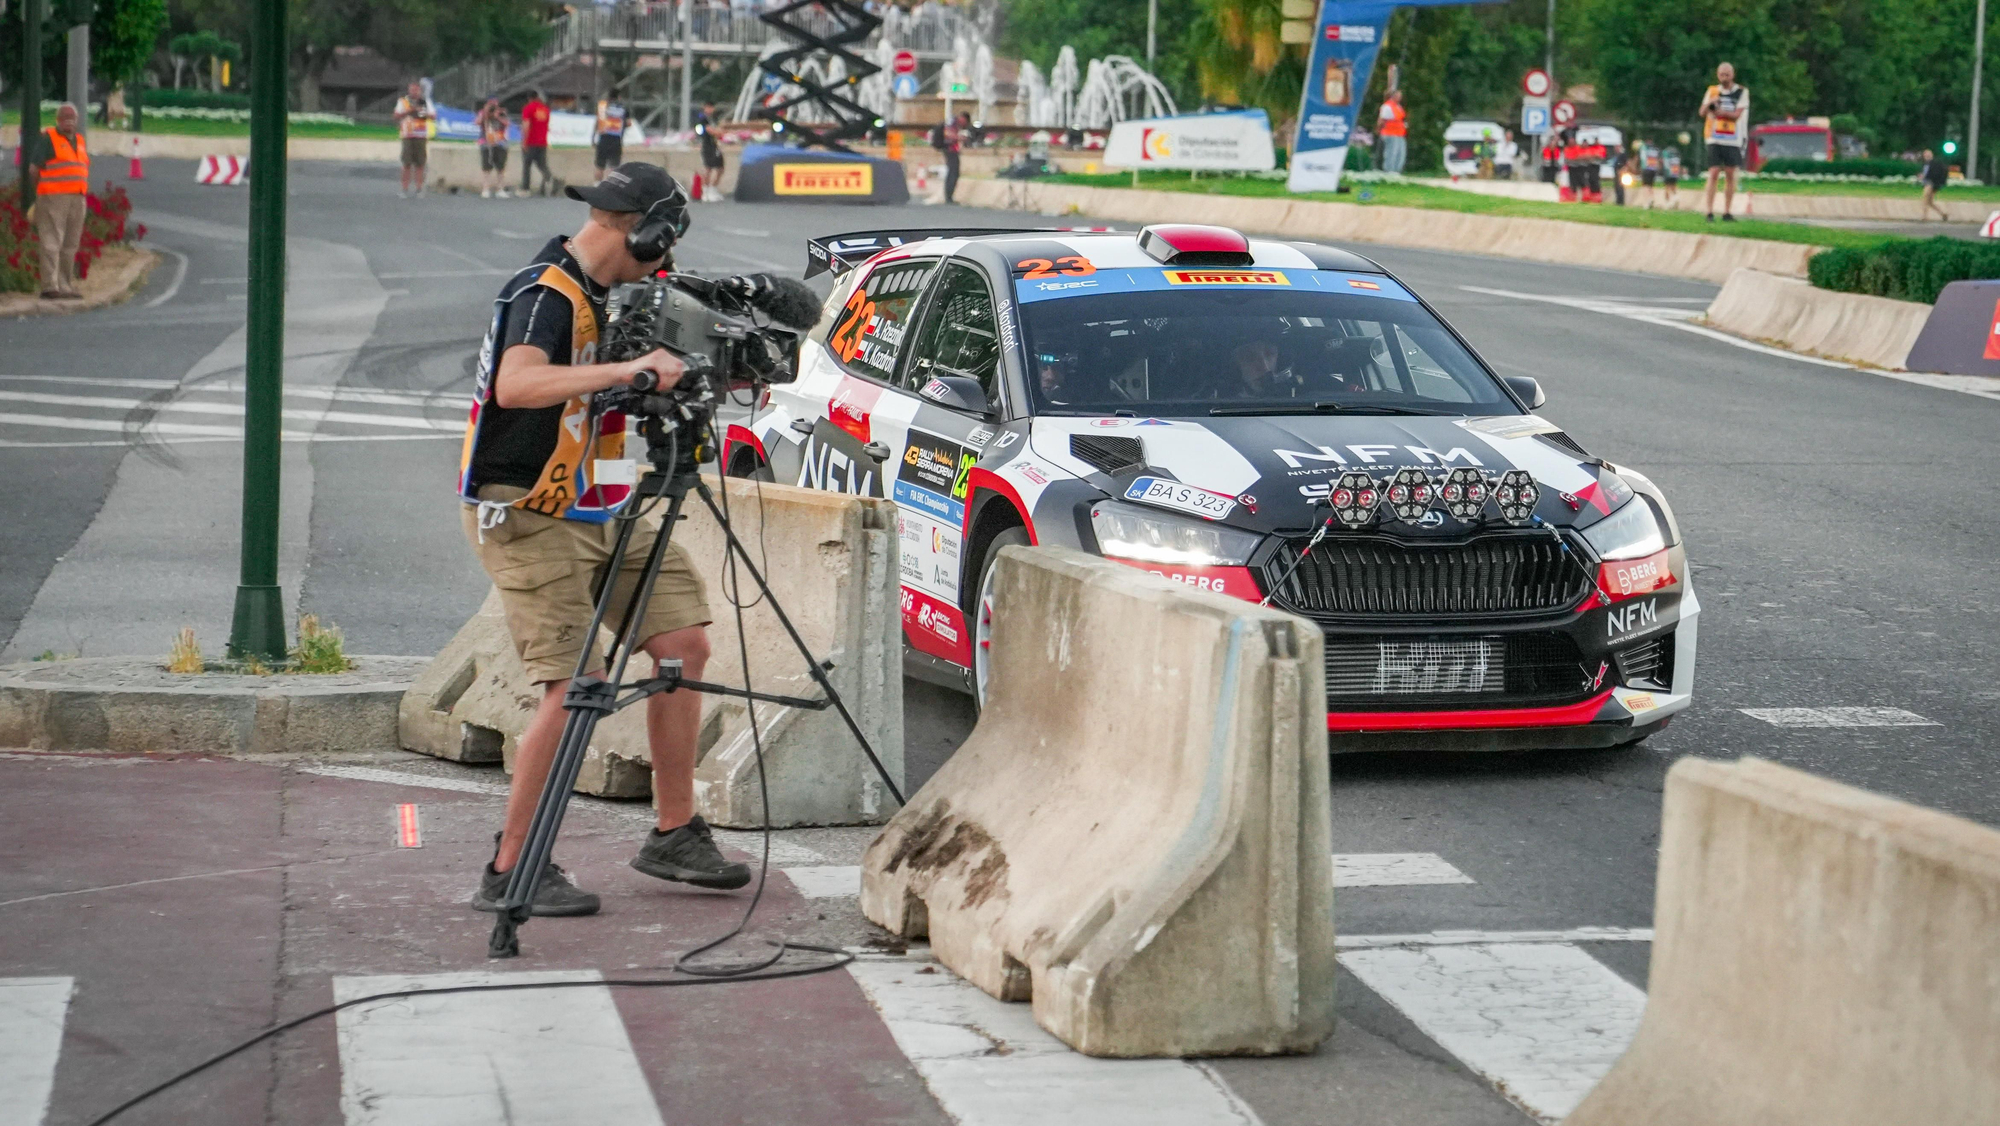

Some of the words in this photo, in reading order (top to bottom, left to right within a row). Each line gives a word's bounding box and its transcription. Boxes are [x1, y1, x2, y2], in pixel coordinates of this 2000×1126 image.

[1528, 110, 1544, 131] P
[784, 171, 861, 188] PIRELLI
[1017, 256, 1097, 281] 23
[1175, 272, 1277, 284] PIRELLI
[831, 289, 876, 363] 23
[797, 434, 873, 497] NFM
[904, 446, 919, 465] 43
[919, 448, 934, 462] RALLY
[1272, 444, 1485, 469] NFM
[1352, 464, 1394, 472] FLEET
[523, 463, 569, 516] ESP
[1130, 489, 1144, 499] SK
[1148, 483, 1174, 499] BA
[1176, 489, 1192, 503] S
[1193, 493, 1227, 512] 323
[1629, 561, 1658, 581] BERG
[1171, 573, 1226, 593] BERG
[900, 588, 914, 611] RG
[1607, 597, 1658, 637] NFM
[1626, 696, 1655, 710] PIRELLI
